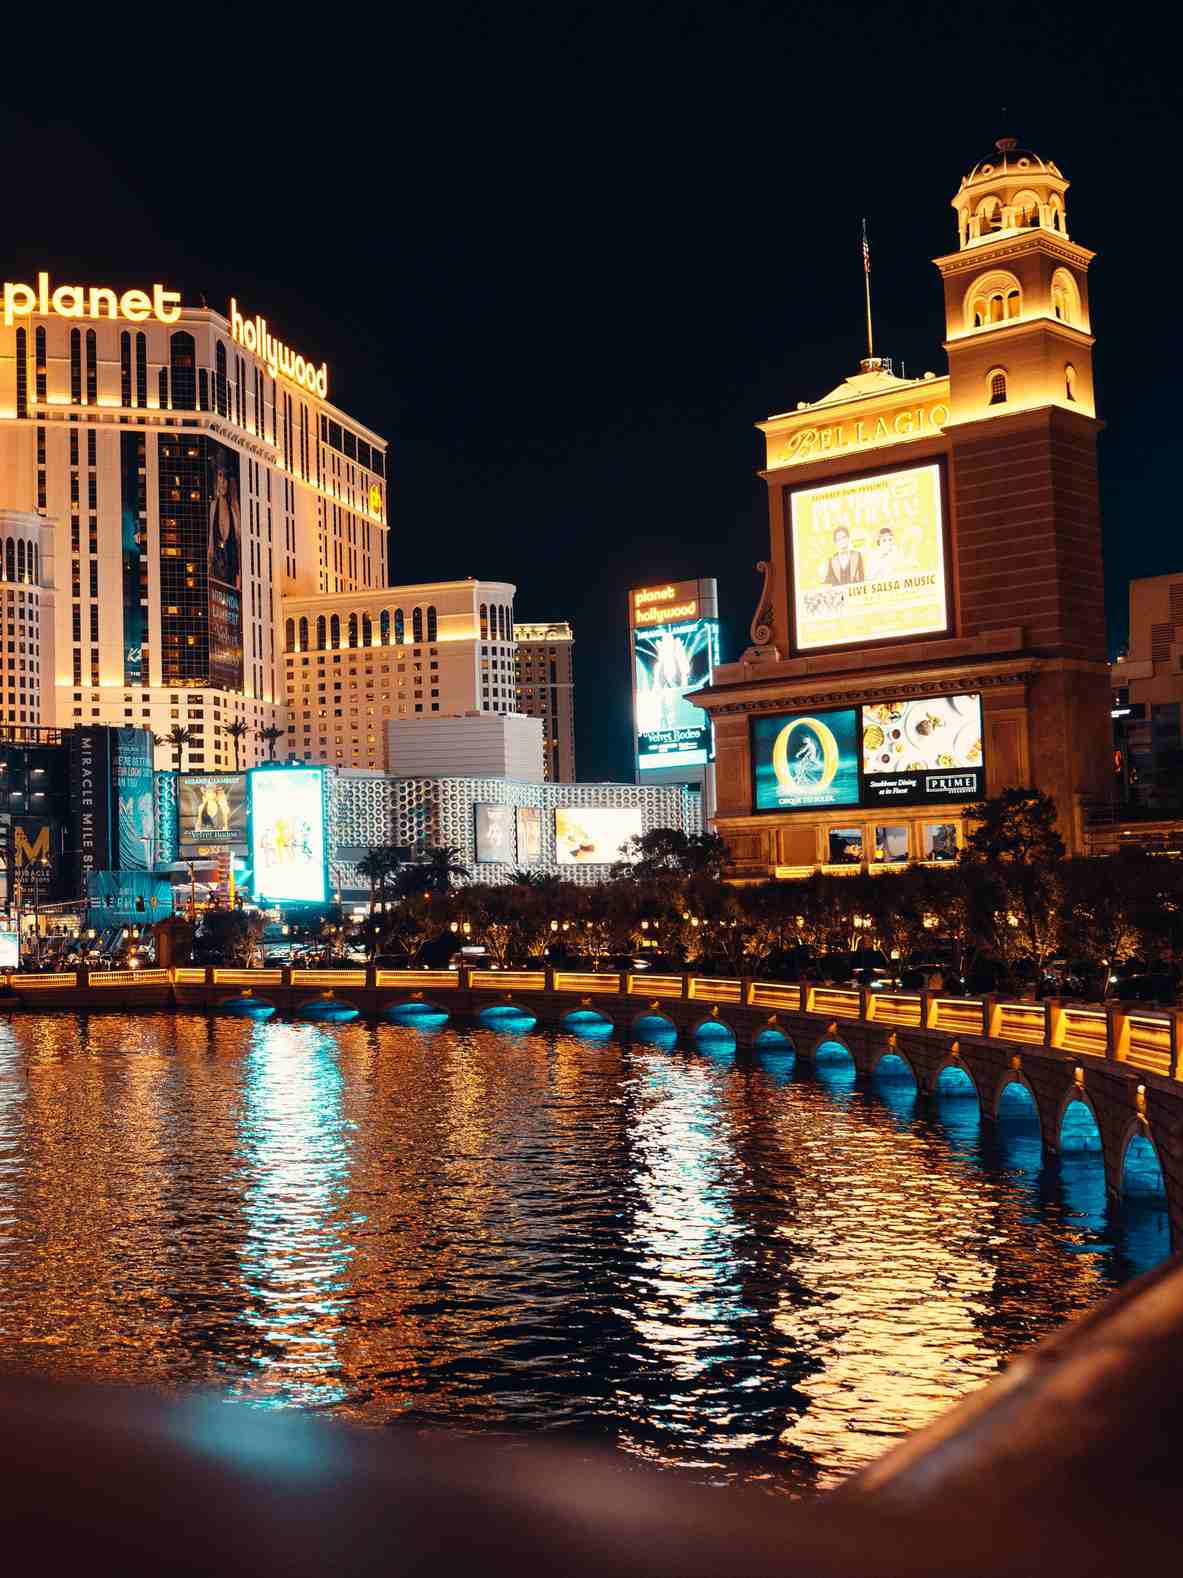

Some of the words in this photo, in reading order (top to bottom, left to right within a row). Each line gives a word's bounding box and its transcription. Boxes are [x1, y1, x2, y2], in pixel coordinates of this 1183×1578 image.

[3, 271, 182, 327] planet
[229, 296, 328, 399] hollywood
[778, 404, 950, 462] BELLAGIO
[634, 585, 676, 608] planet
[848, 584, 868, 597] LIVE
[871, 580, 900, 594] SALSA
[903, 573, 937, 588] MUSIC
[635, 600, 696, 623] hollywood
[81, 737, 94, 806] MIRACLE
[931, 777, 972, 789] PRIME
[82, 813, 94, 848] MILE
